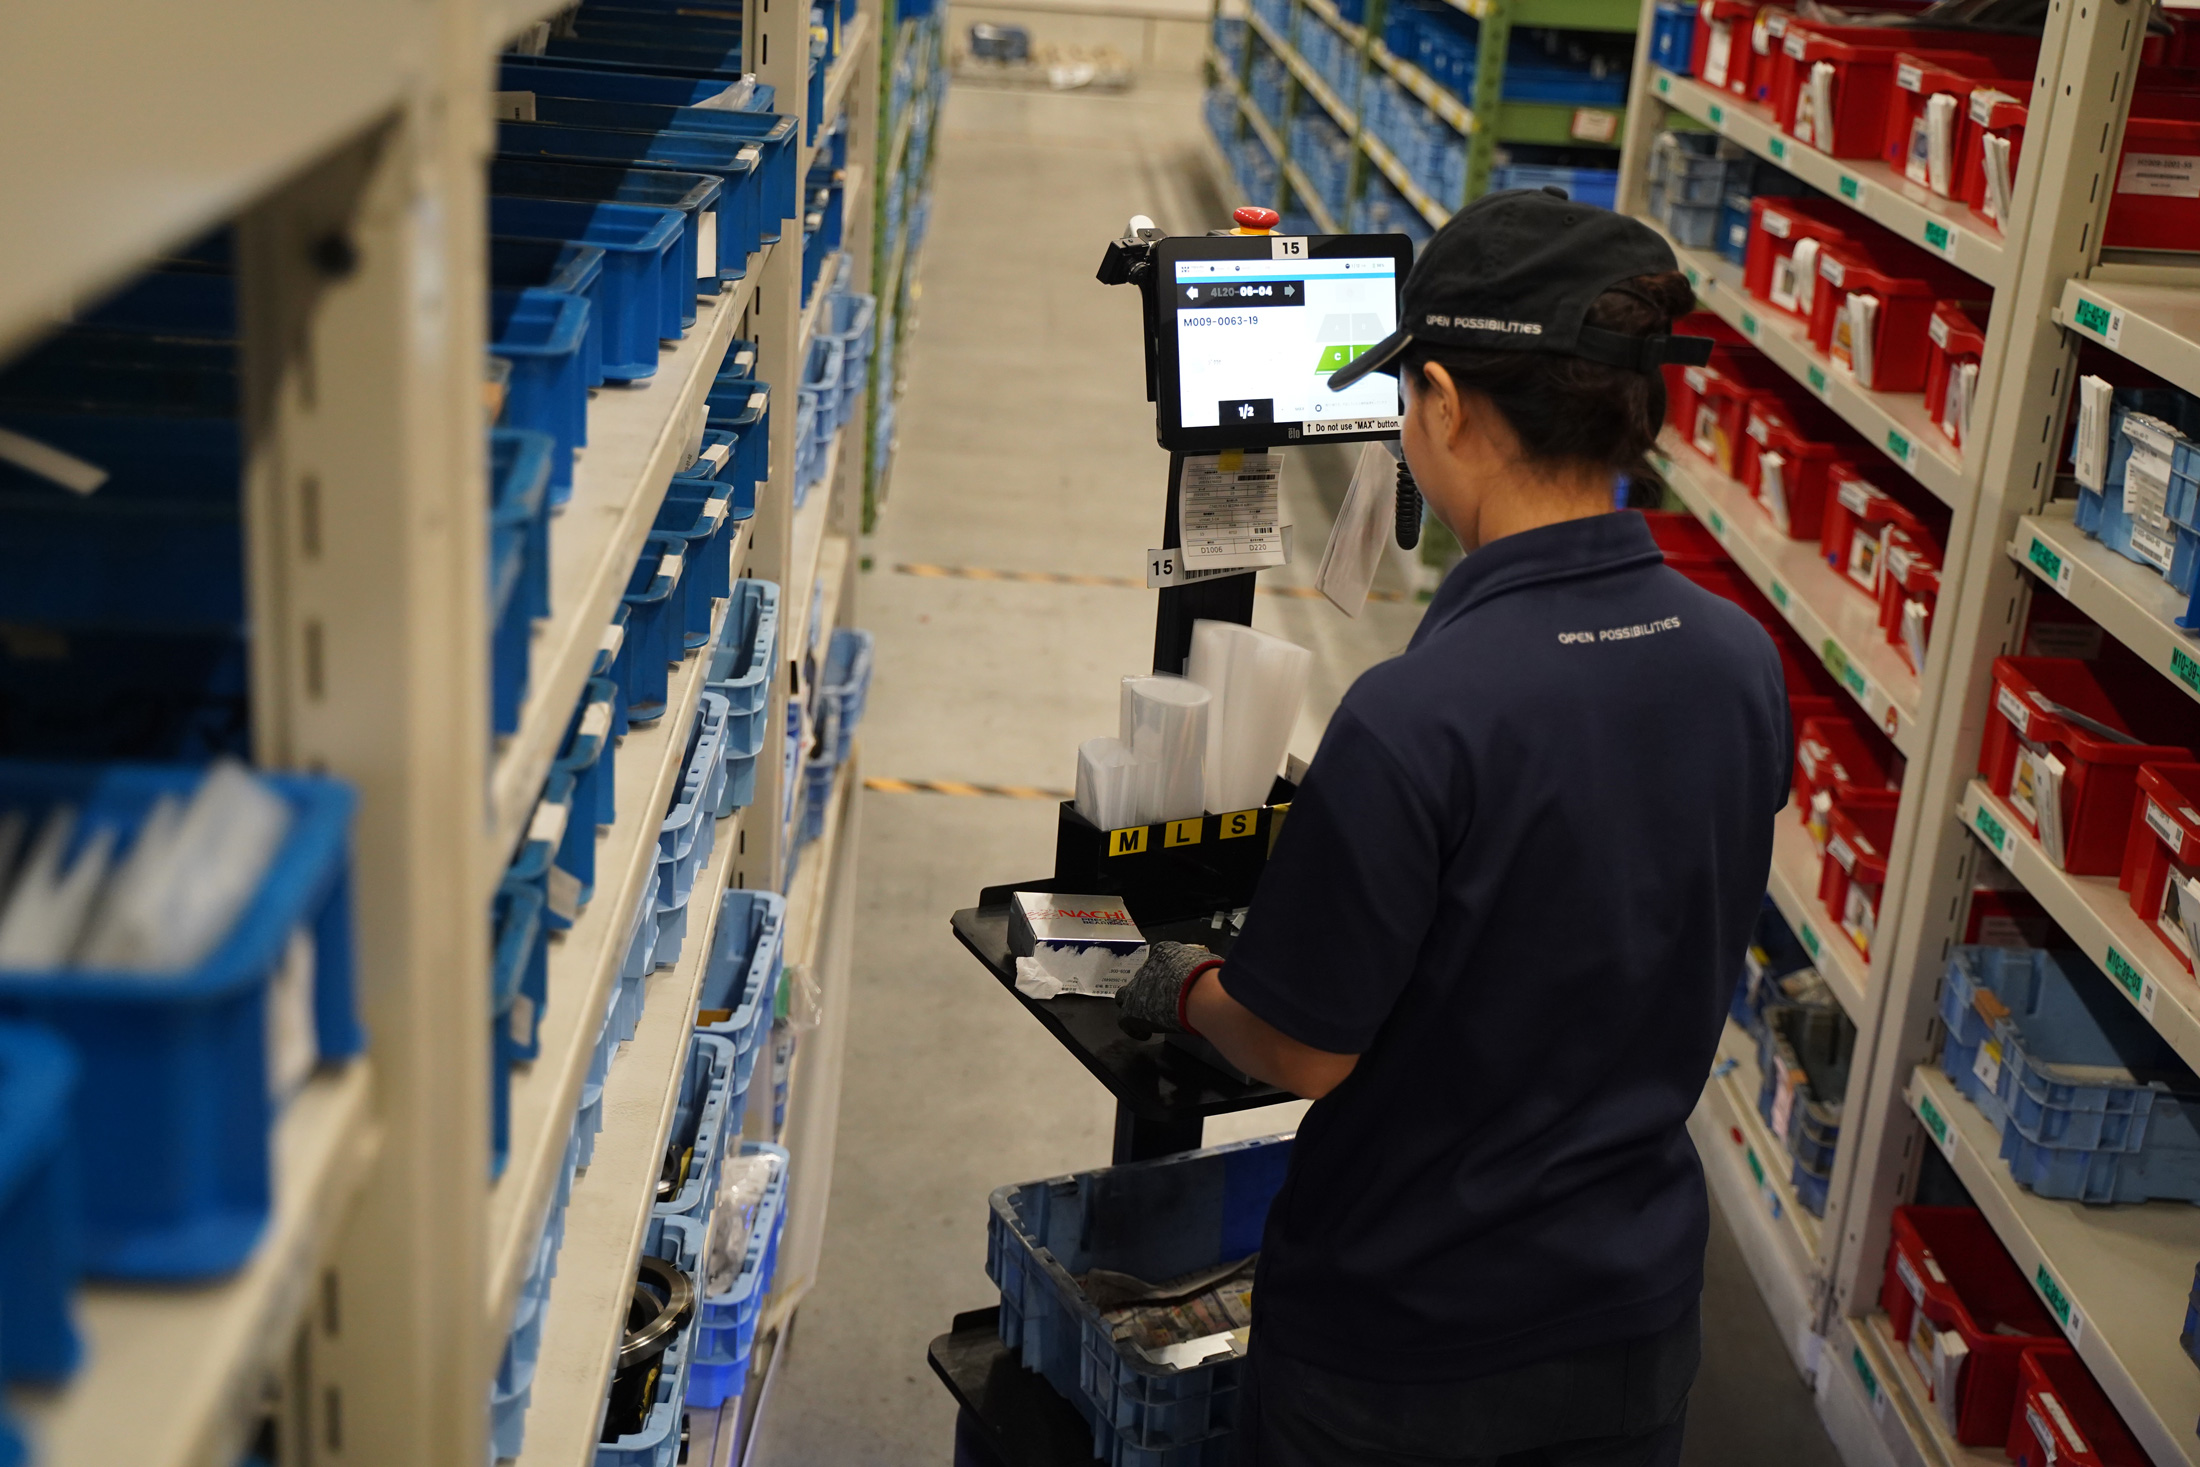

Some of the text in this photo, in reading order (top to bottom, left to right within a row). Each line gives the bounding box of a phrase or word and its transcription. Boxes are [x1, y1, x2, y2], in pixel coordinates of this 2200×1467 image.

[1282, 242, 1300, 255] 15
[1183, 315, 1259, 327] M009-0063-19
[1426, 314, 1542, 335] OPEN POSSIBILITIES
[1334, 352, 1342, 361] C
[1238, 405, 1254, 419] 1/2
[1315, 420, 1400, 432] Do not use "MAX" button.
[1249, 543, 1267, 551] D220
[1152, 559, 1173, 576] 15
[1558, 616, 1680, 644] OPEN POSSIBILITIES
[1231, 814, 1246, 834] S
[1118, 829, 1140, 852] M
[1176, 823, 1190, 843] L
